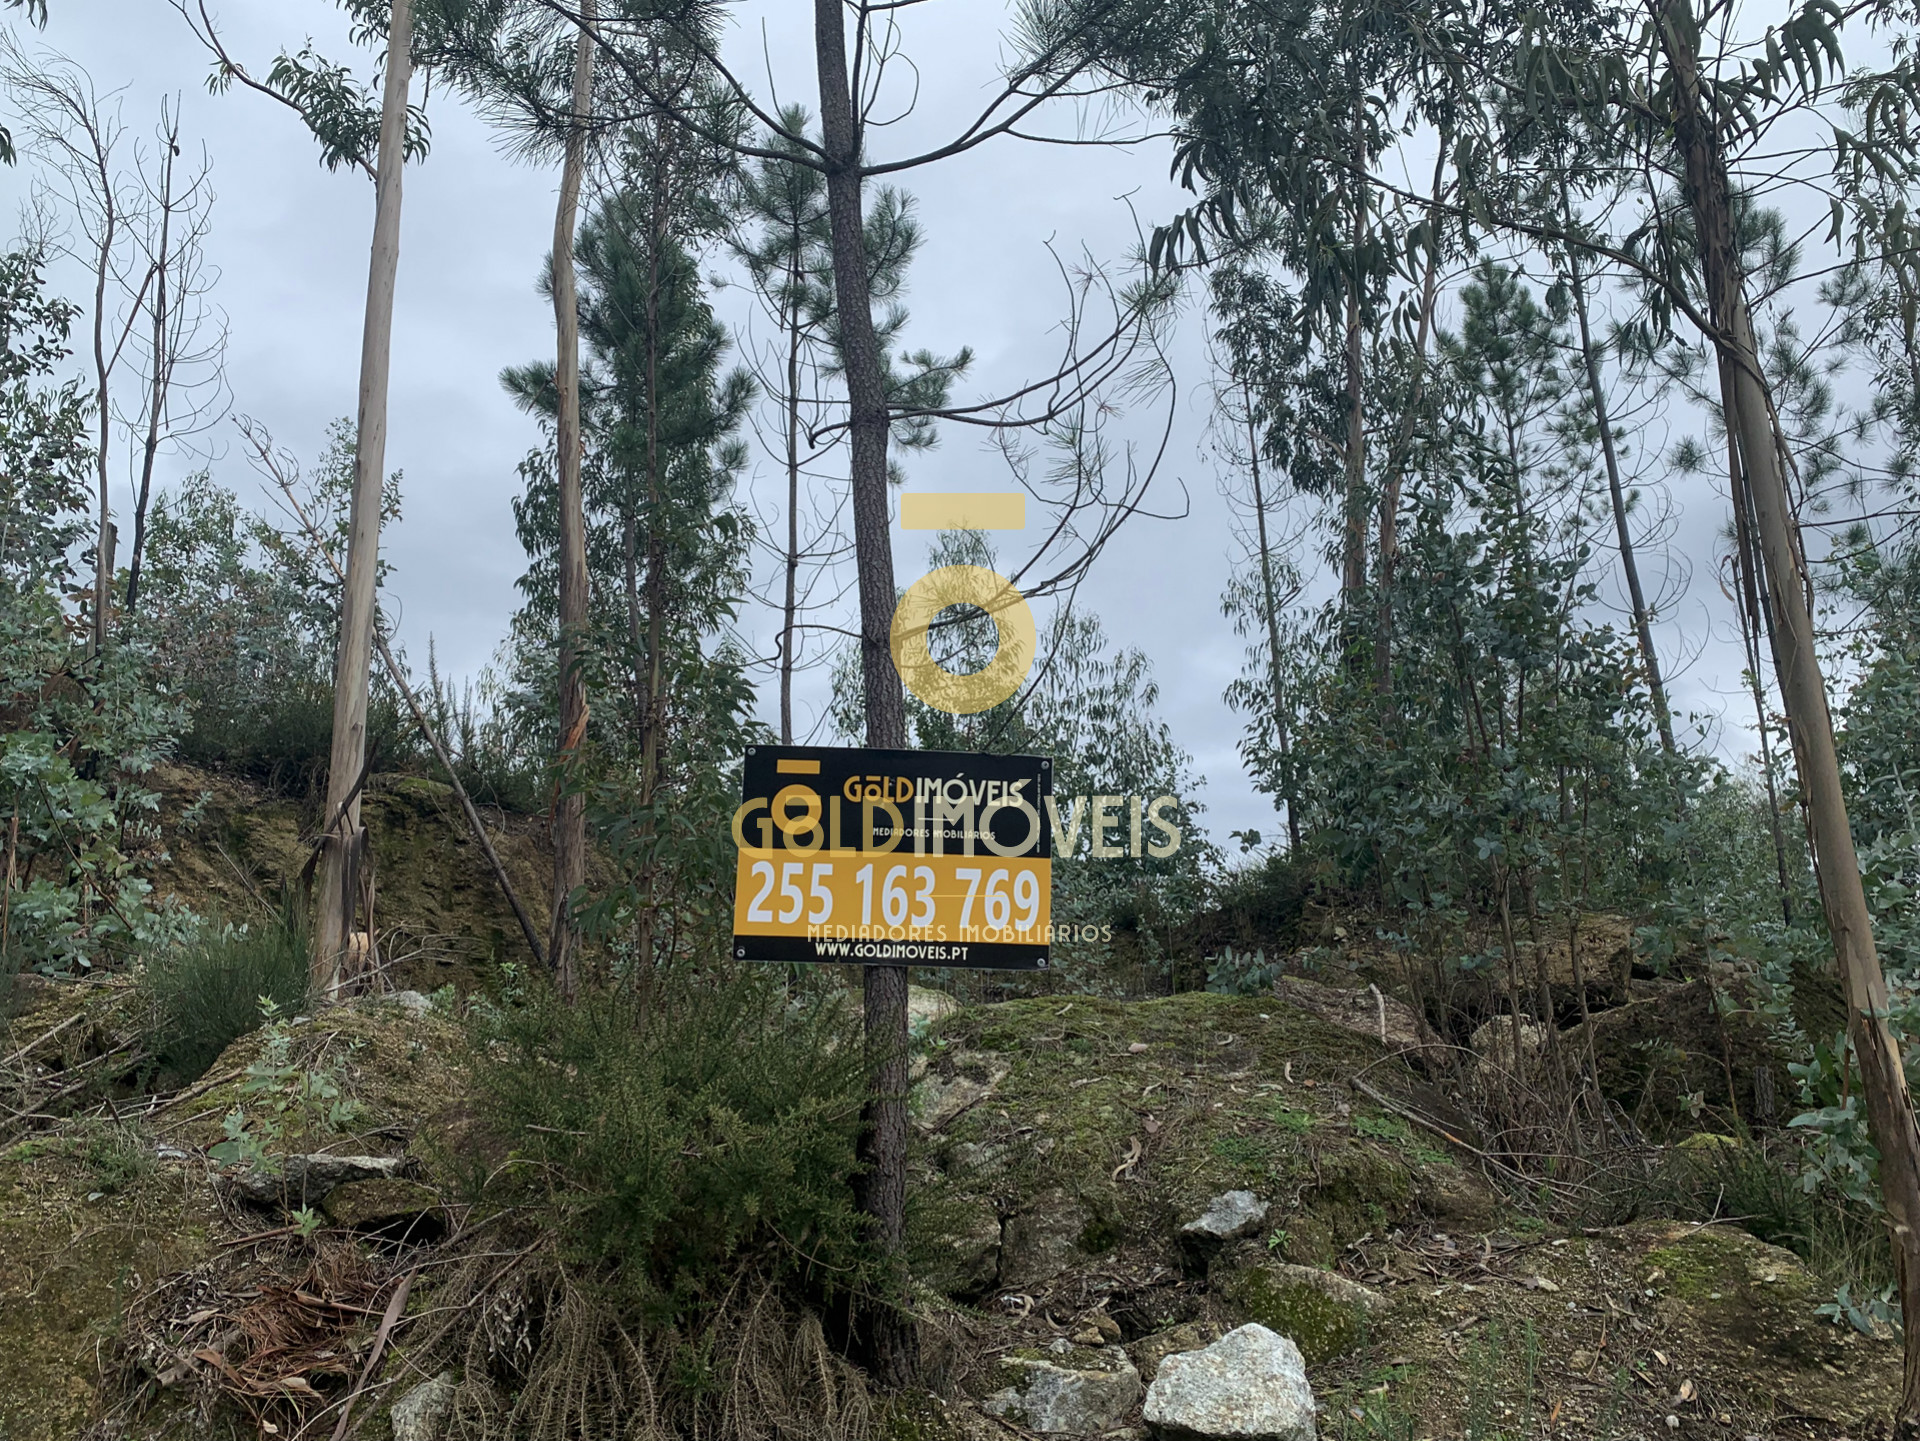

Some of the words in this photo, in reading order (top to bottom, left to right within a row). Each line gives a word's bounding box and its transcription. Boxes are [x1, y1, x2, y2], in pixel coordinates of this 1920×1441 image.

[873, 826, 930, 838] MEDIADORES
[747, 860, 833, 925] 255
[856, 863, 936, 928] 163
[955, 868, 1040, 932] 769
[815, 942, 968, 961] WWW.GOLDIMOVEIS.PT
